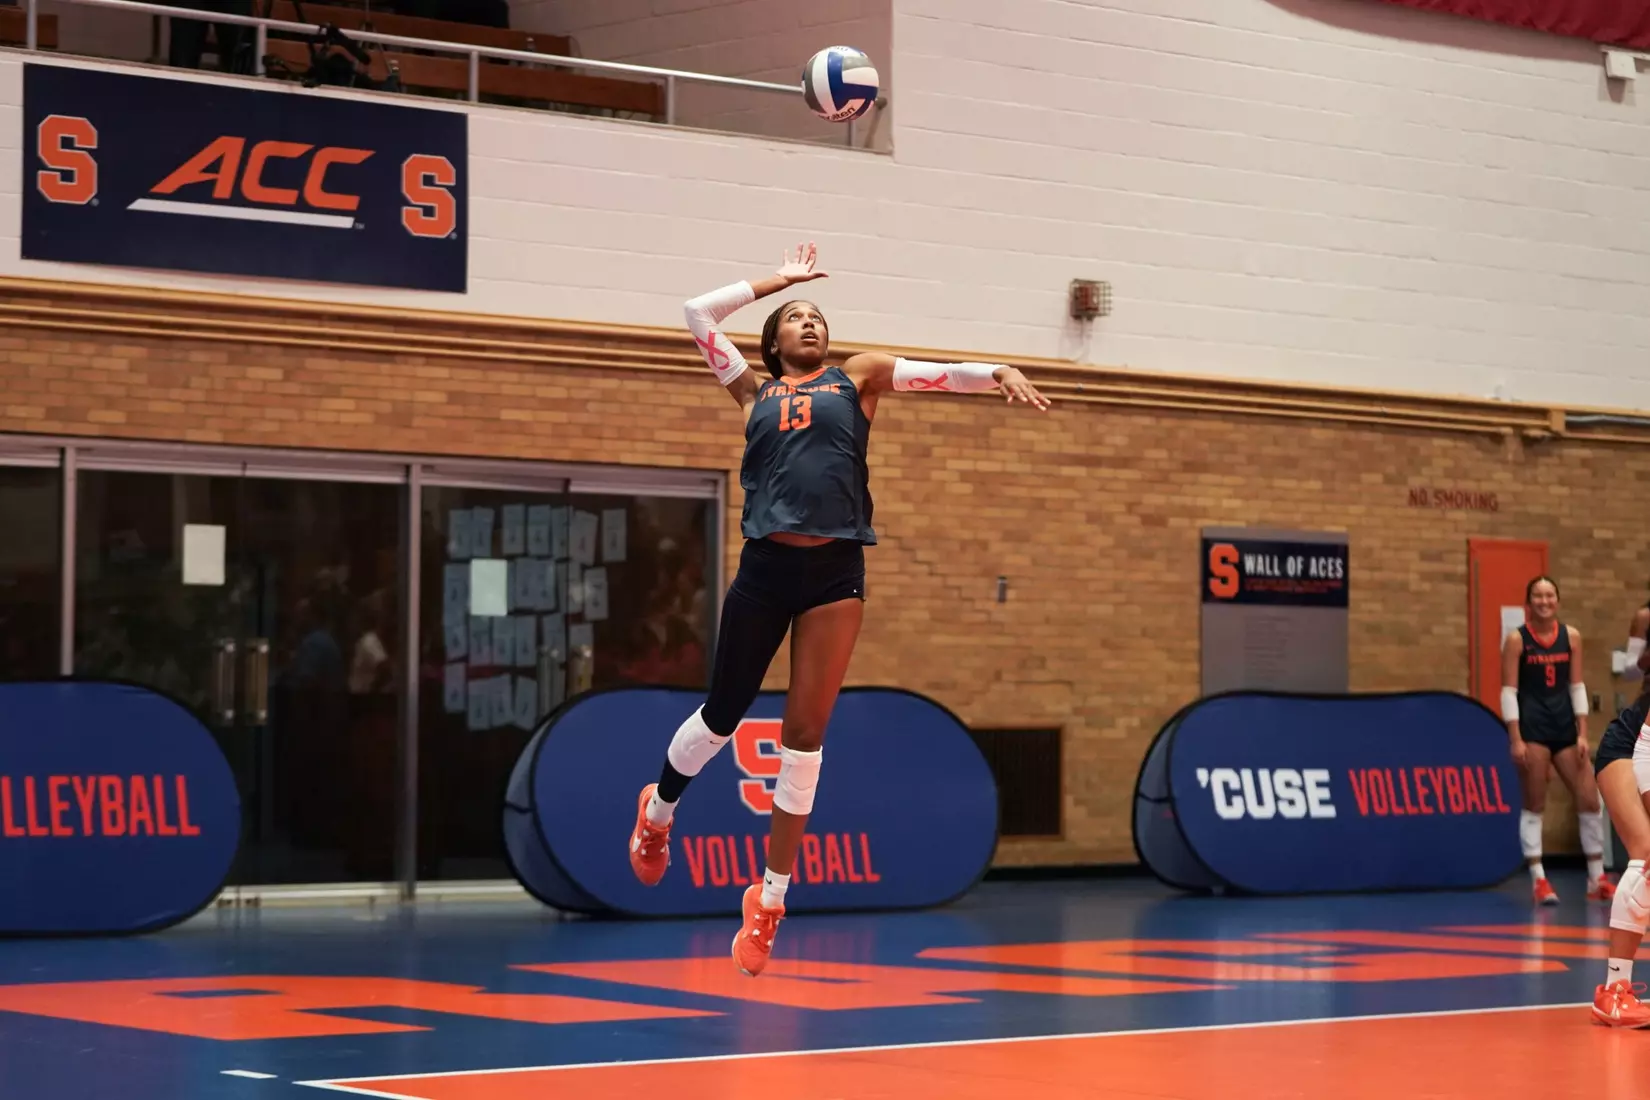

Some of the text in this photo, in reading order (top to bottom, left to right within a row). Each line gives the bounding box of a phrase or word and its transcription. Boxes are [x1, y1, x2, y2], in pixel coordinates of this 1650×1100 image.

[37, 114, 98, 205] S
[149, 136, 375, 211] ACC
[401, 153, 456, 239] S
[778, 395, 813, 432] 13
[1408, 487, 1499, 511] NO SMOKING
[1209, 543, 1239, 599] S
[1244, 553, 1344, 579] WALL OF ACES
[1545, 665, 1556, 687] 9
[1, 775, 201, 837] LLEYBALL
[1196, 766, 1511, 820] 'CUSE VOLLEYBALL
[682, 832, 881, 889] VOLLBALL
